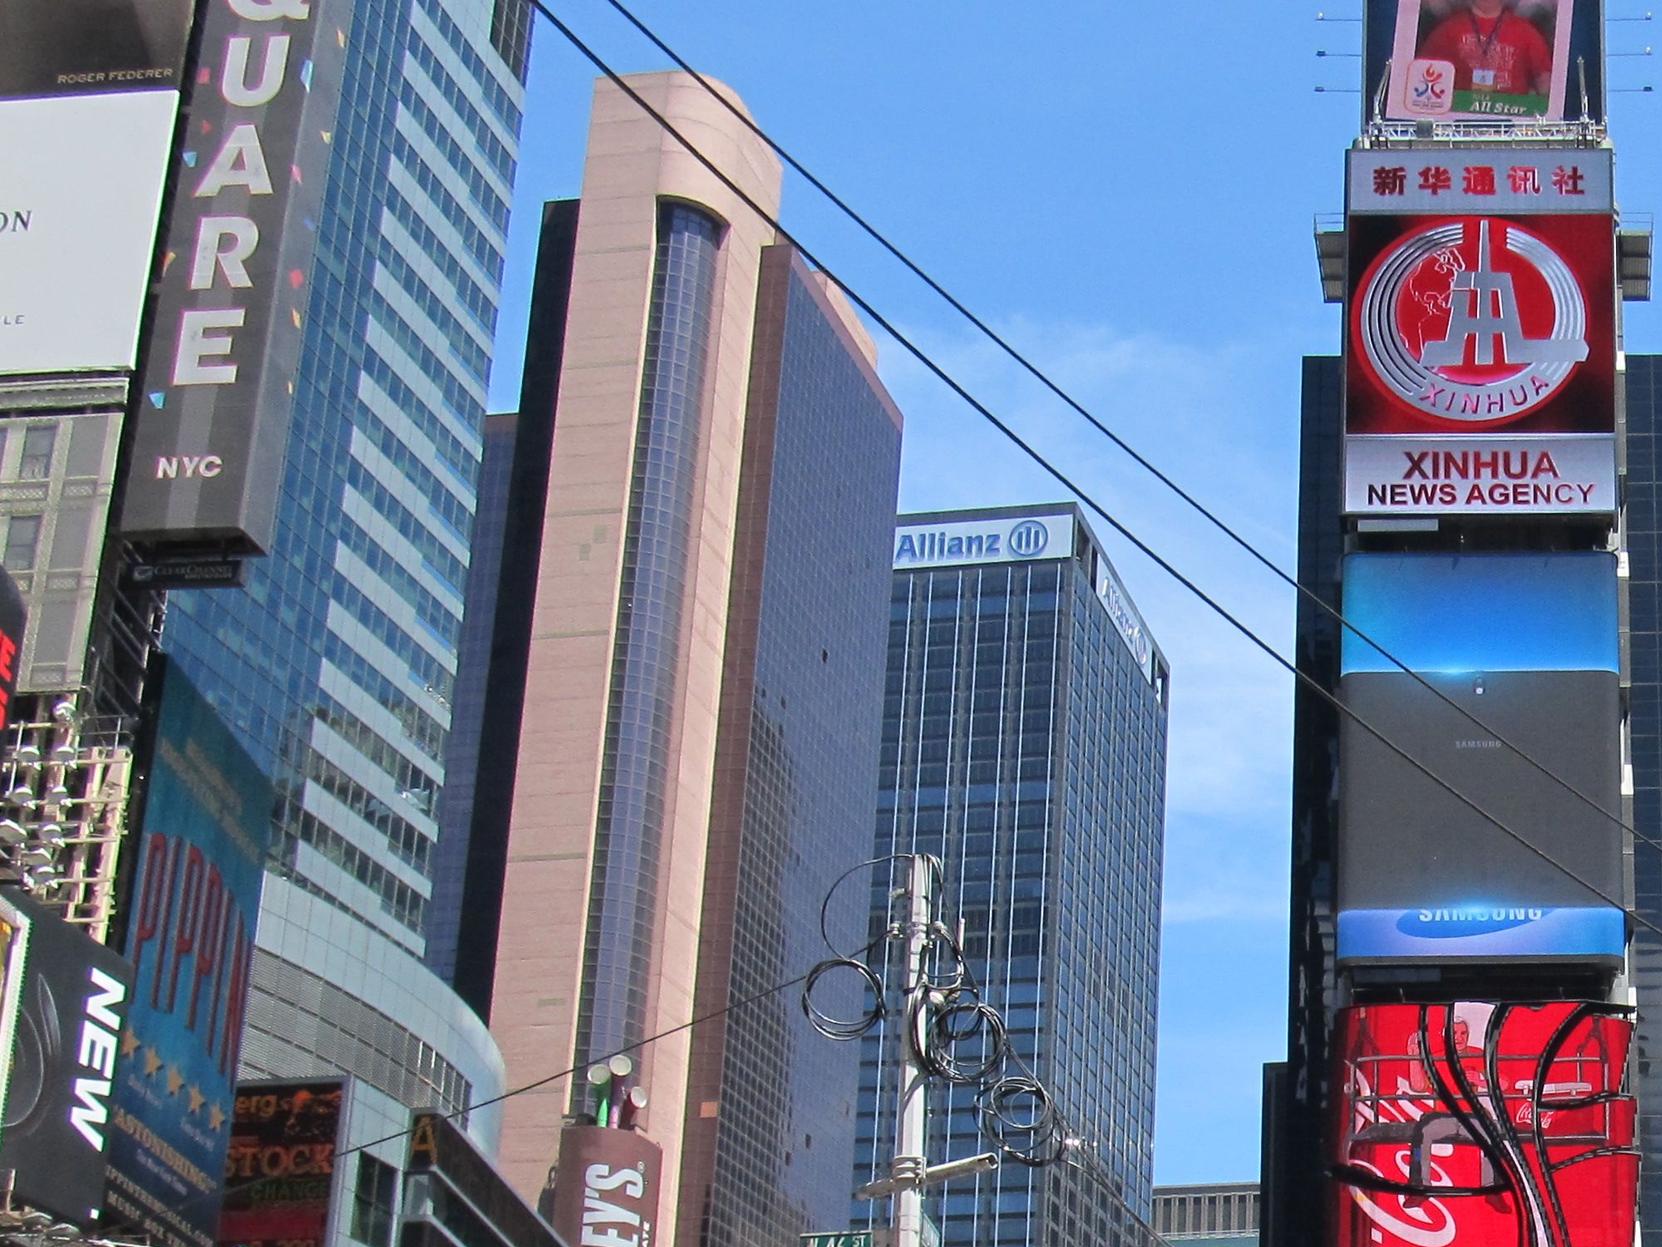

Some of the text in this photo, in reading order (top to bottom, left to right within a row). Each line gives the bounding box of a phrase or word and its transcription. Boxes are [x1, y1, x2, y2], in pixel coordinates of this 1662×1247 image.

[57, 68, 174, 85] ROGER FEDERER
[1469, 101, 1527, 115] All Star
[172, 0, 310, 387] UARE
[1372, 165, 1586, 197] 新华通讯社
[1419, 374, 1549, 415] XINHUA
[155, 455, 223, 480] NYC
[1402, 450, 1560, 480] XINHUA
[1368, 482, 1596, 506] NEWS AGENCY
[895, 531, 1001, 563] Allianz
[1455, 740, 1502, 749] SAMSUNG
[1418, 908, 1543, 922] SAMSUNG
[70, 967, 128, 1153] NEW
